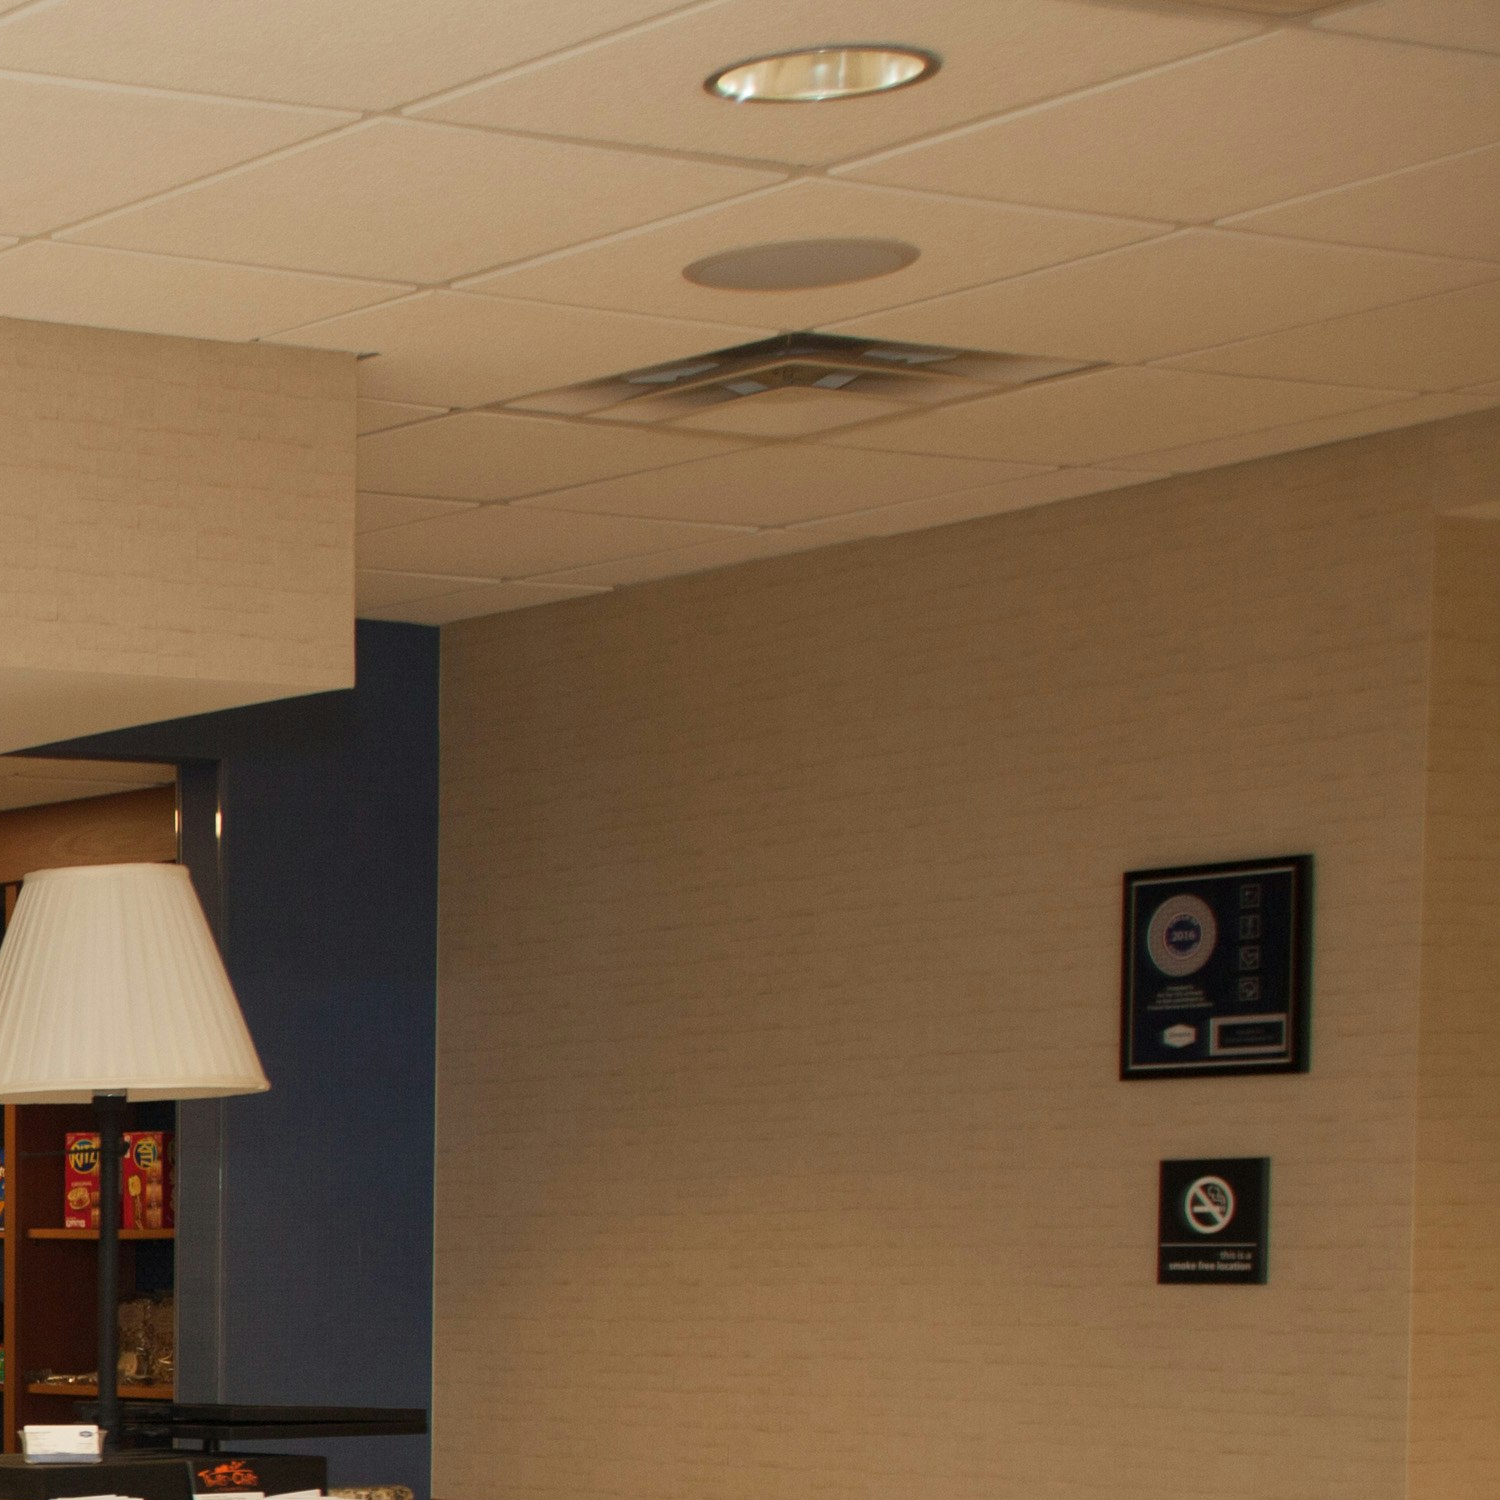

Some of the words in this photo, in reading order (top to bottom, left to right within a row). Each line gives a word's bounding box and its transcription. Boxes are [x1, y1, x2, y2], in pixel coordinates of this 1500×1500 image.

[1220, 1251, 1235, 1260] this
[1237, 1251, 1244, 1260] is
[1169, 1261, 1196, 1271] smoke
[1198, 1261, 1215, 1271] free
[1217, 1261, 1252, 1271] location
